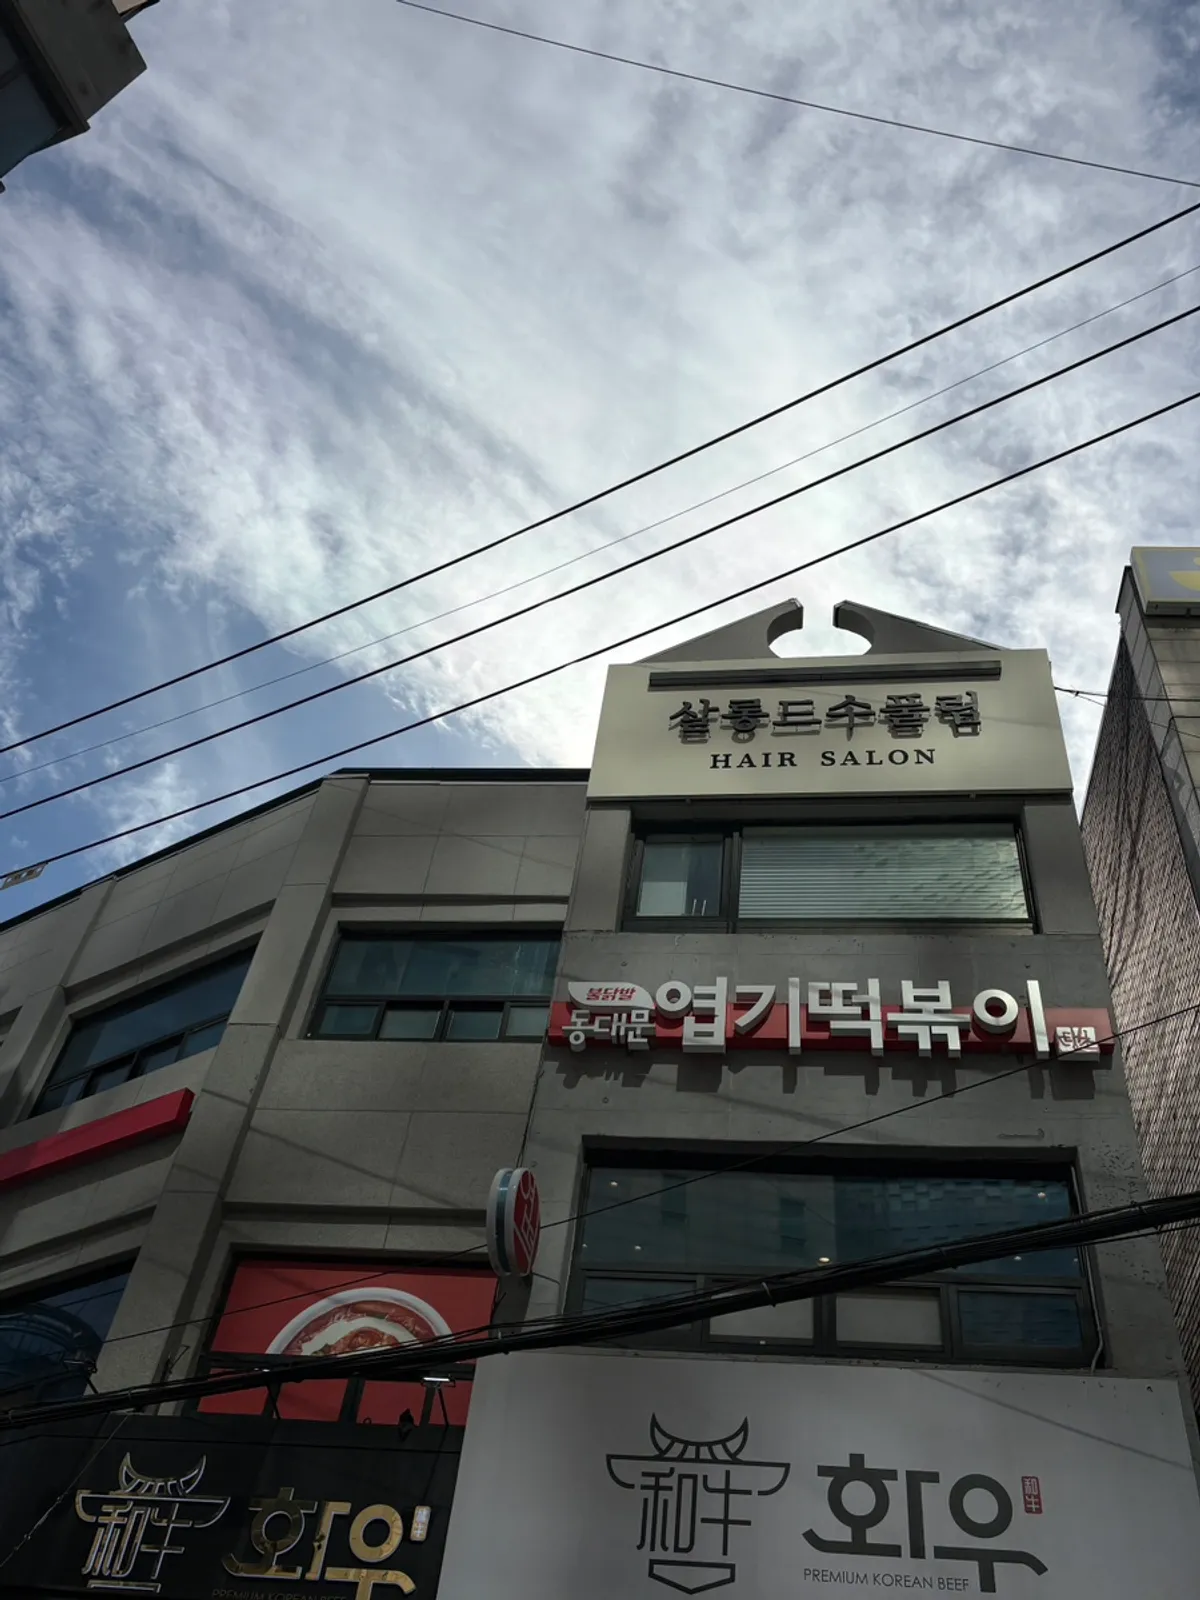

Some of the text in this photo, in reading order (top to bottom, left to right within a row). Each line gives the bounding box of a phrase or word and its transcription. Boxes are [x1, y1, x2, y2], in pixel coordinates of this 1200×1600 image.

[709, 748, 936, 769] HAIR SALON
[562, 1009, 656, 1049] 동대문
[655, 976, 1050, 1058] 엽기떡볶이
[222, 1487, 416, 1600] 화우
[802, 1453, 1048, 1593] 화우
[803, 1567, 970, 1592] PREMIUM KOREAN BEEF
